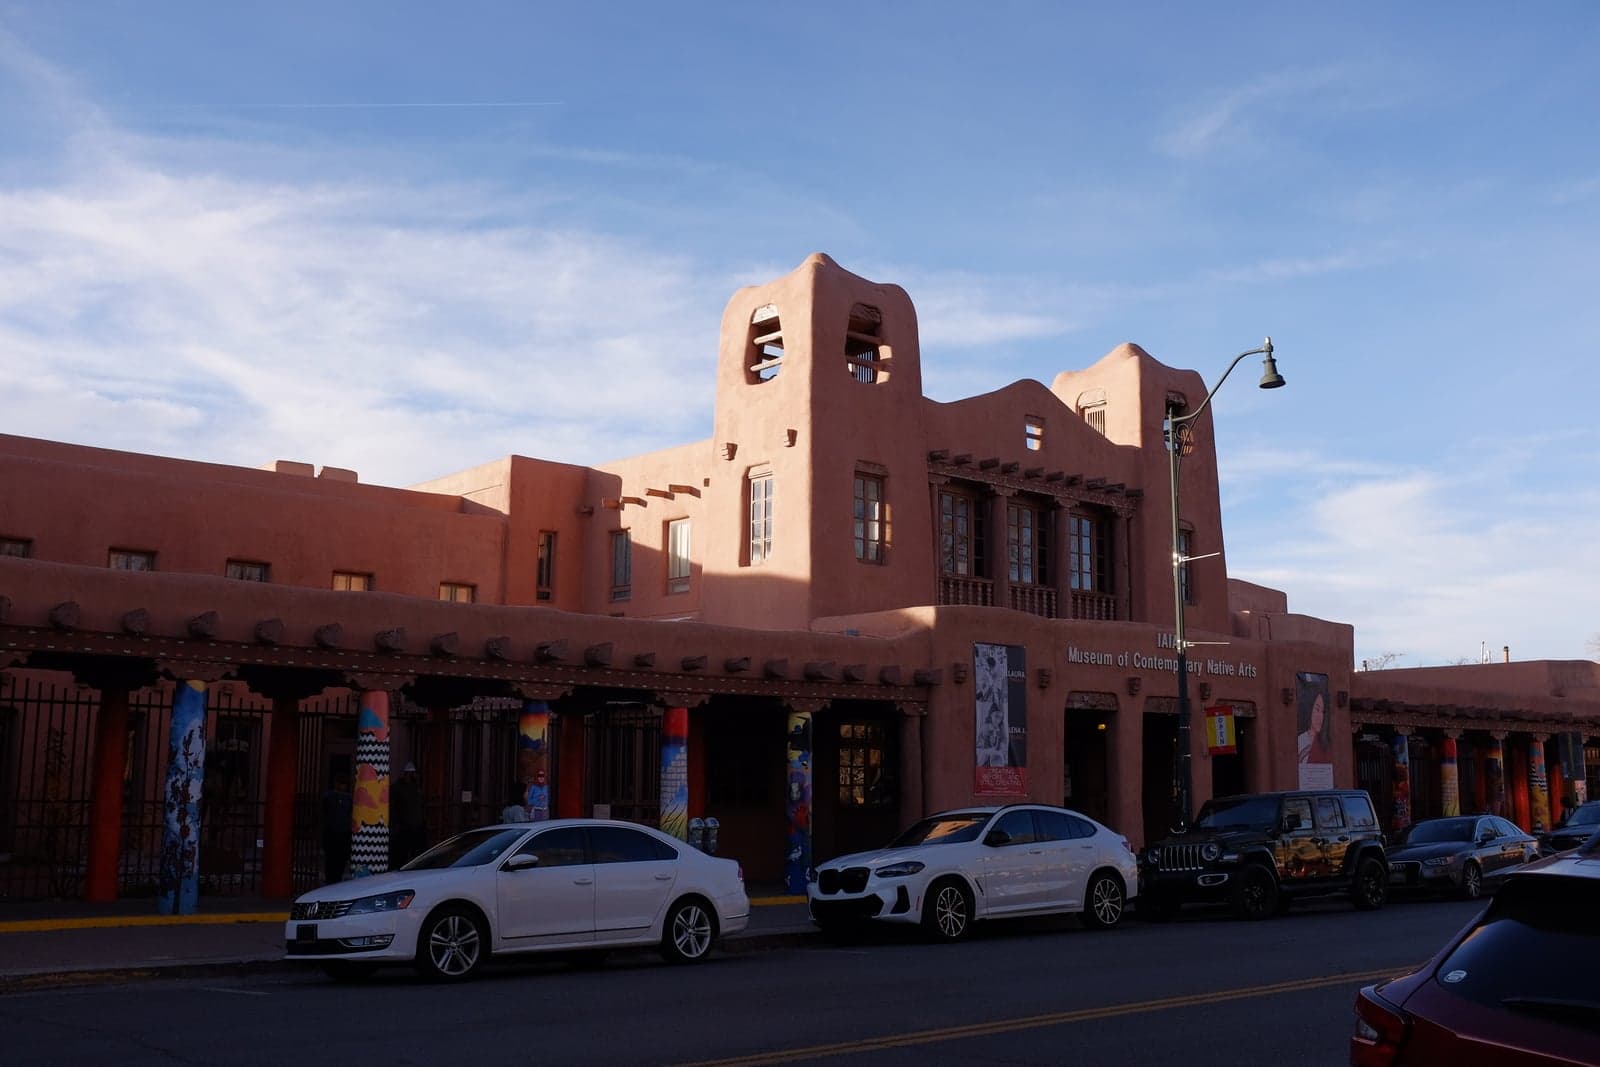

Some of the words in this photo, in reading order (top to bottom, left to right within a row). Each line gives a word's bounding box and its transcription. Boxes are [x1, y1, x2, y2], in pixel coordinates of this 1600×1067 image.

[1067, 646, 1113, 666] Museum
[1118, 652, 1129, 667] of
[1133, 652, 1203, 677] Contemprary
[1207, 659, 1234, 675] Native
[1239, 663, 1257, 678] Arts
